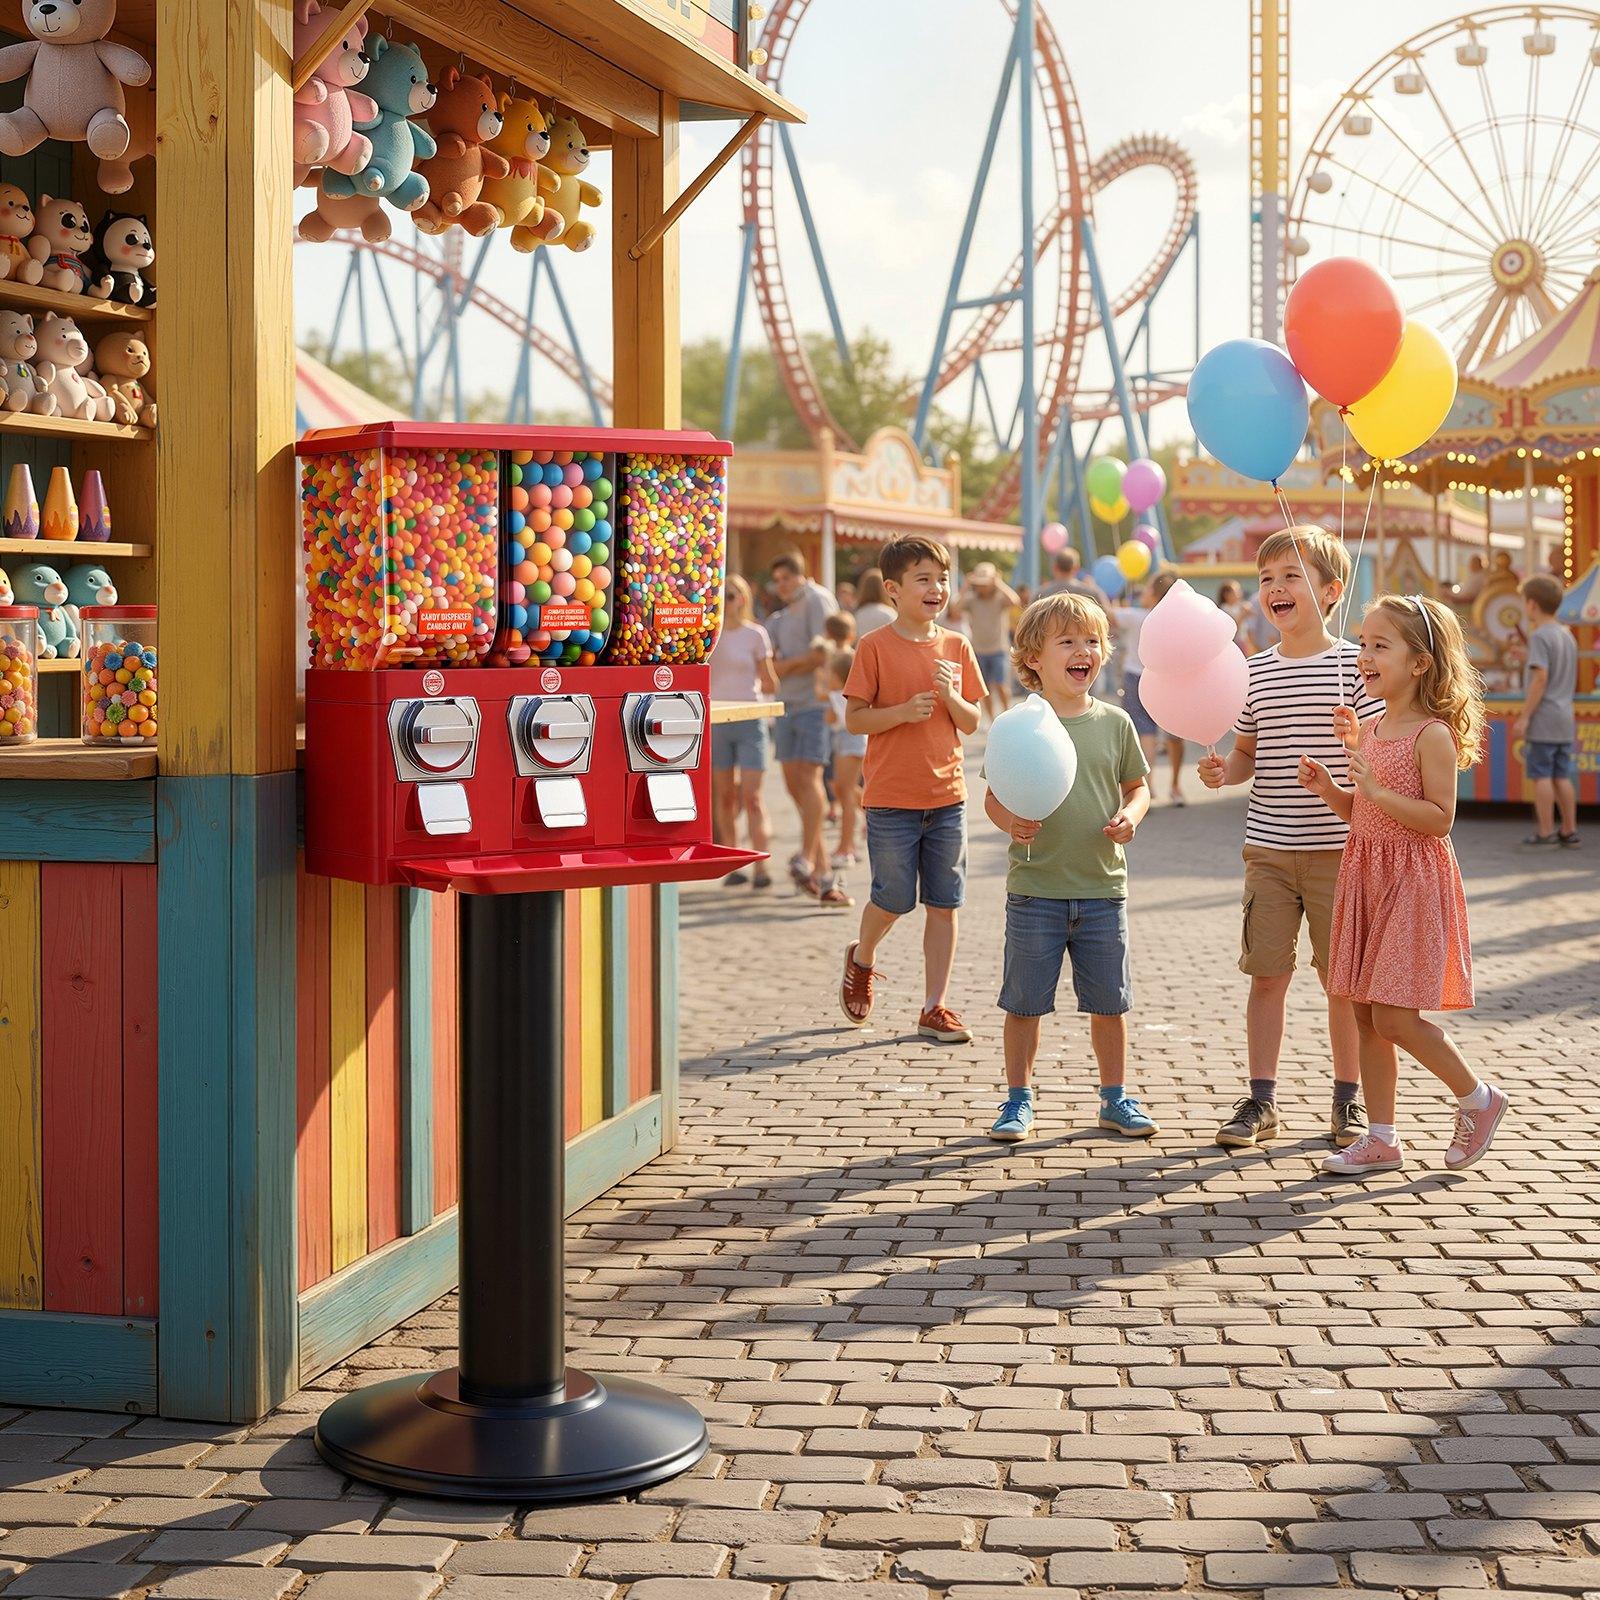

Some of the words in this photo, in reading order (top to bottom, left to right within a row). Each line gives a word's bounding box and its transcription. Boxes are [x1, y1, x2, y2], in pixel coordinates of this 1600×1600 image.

[421, 613, 440, 621] CANDY
[441, 612, 472, 620] DISPENSER
[452, 622, 467, 630] ONLY
